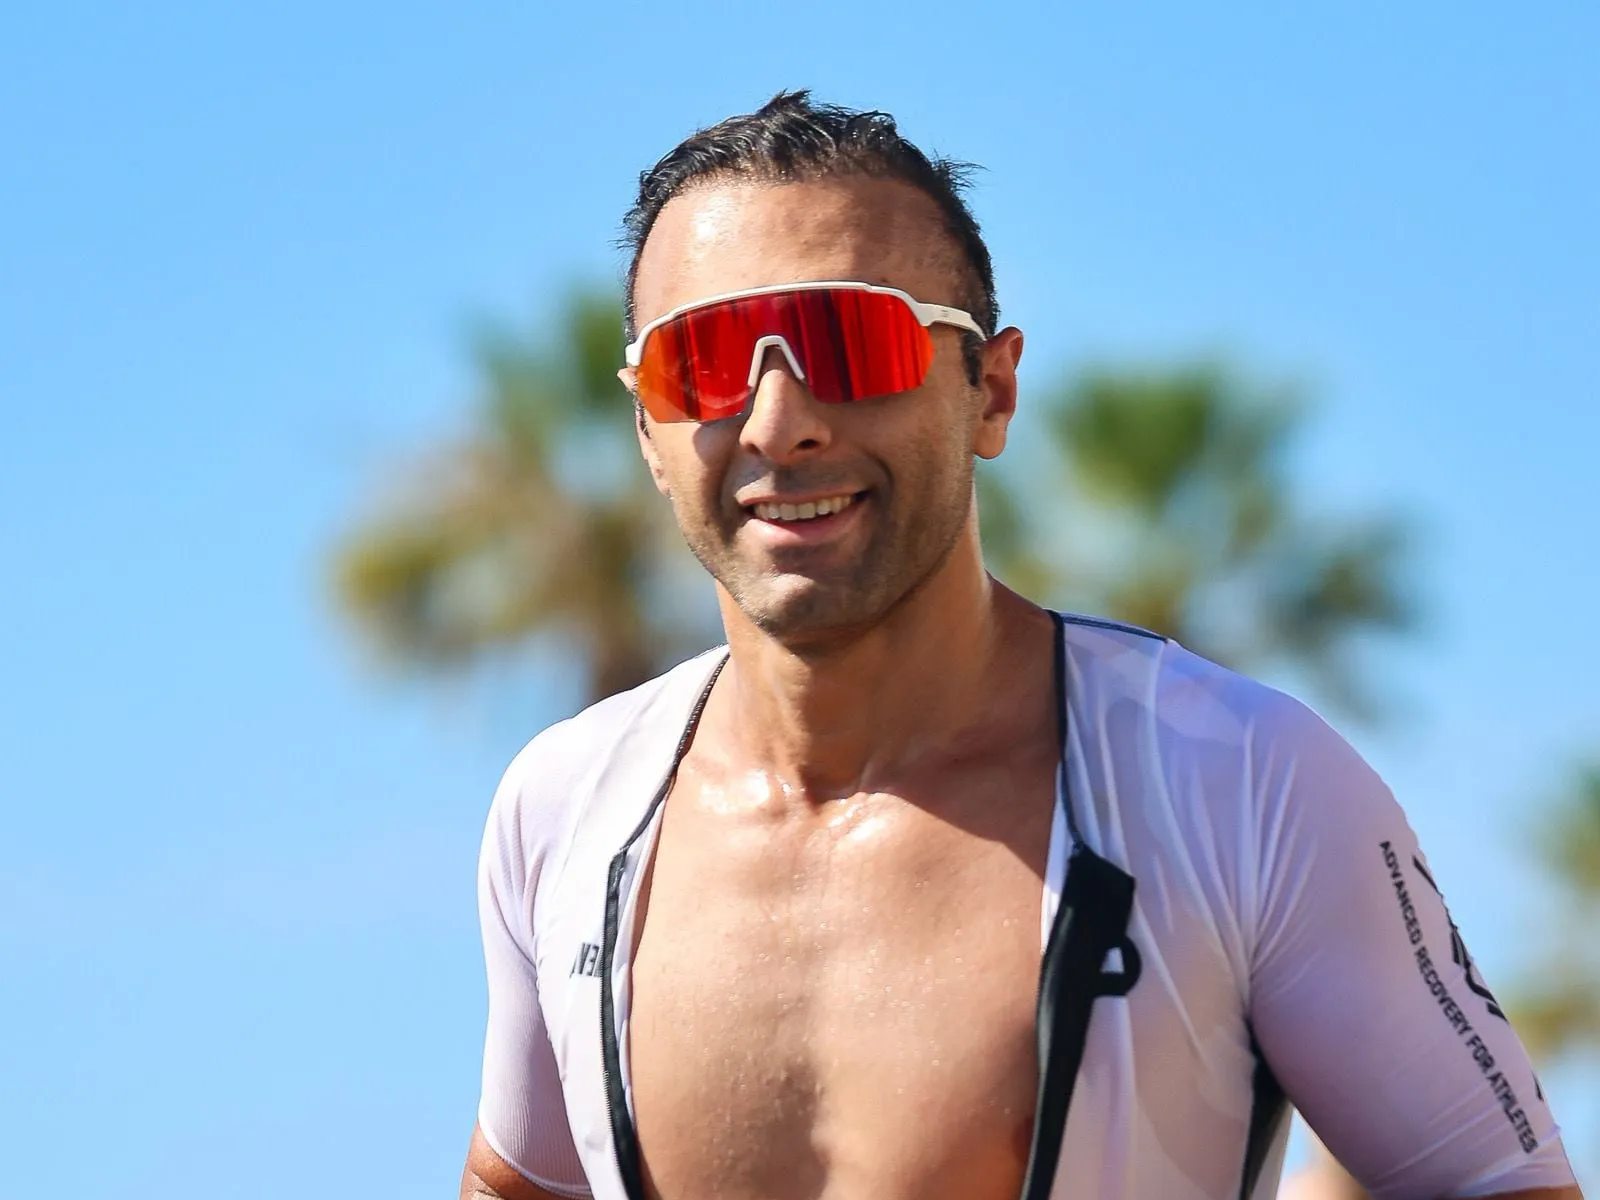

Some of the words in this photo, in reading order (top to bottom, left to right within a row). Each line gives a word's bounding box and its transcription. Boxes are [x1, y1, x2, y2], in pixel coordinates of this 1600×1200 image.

[1379, 840, 1423, 946] ADVANCED
[1414, 945, 1473, 1036] RECOVERY
[1465, 1034, 1496, 1074] FOR
[1486, 1071, 1539, 1154] ATHLETES
